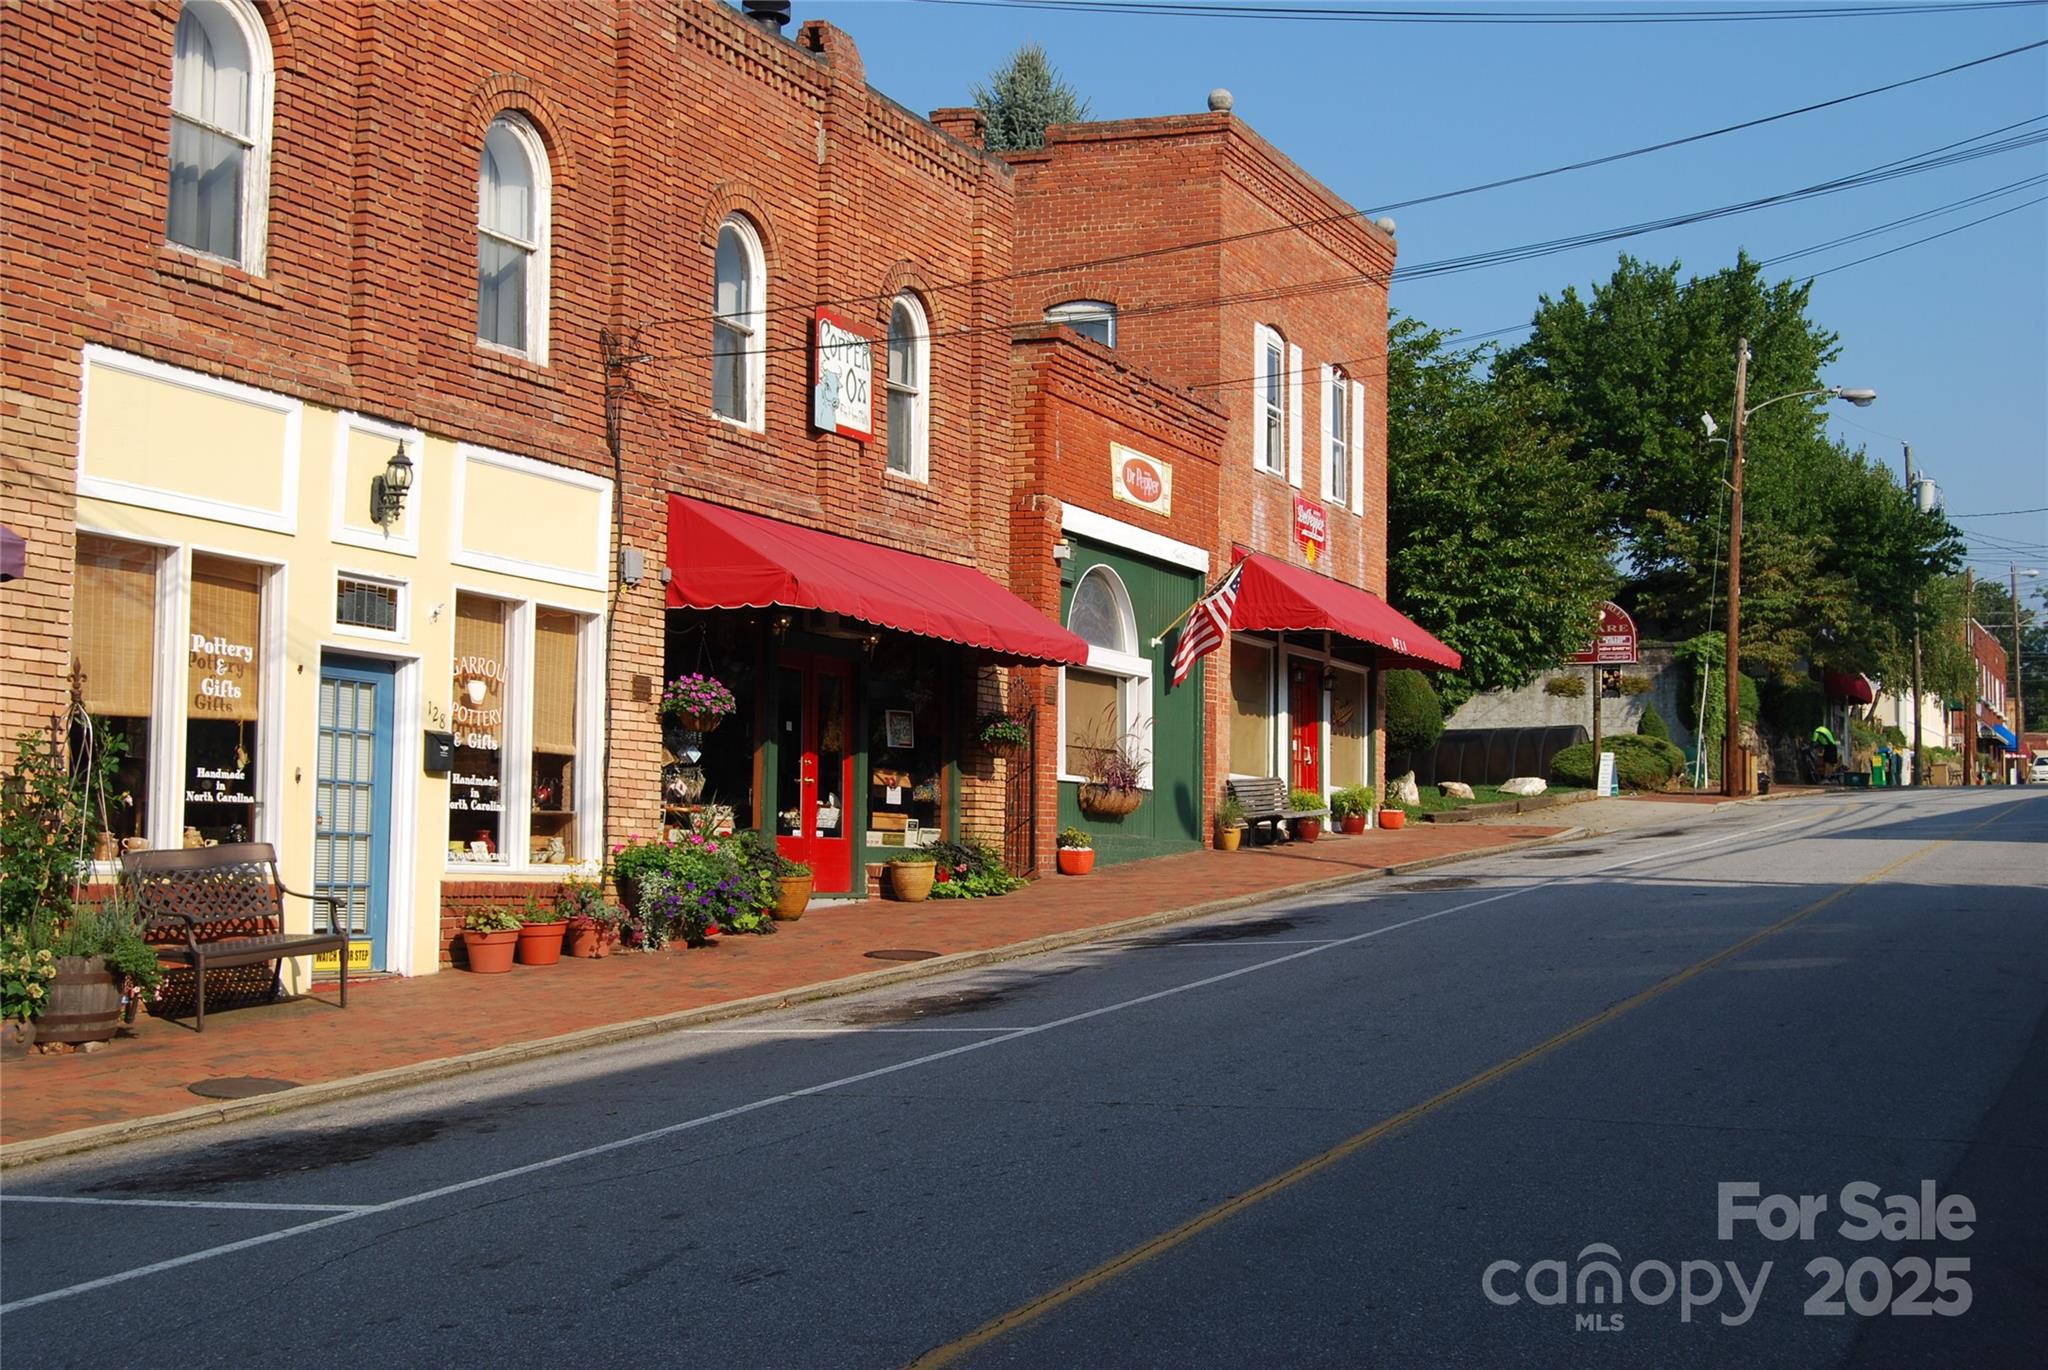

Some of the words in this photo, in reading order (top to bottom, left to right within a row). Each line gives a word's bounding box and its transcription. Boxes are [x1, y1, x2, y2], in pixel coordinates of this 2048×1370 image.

[190, 633, 254, 663] Pottery
[216, 658, 229, 676] &
[201, 678, 242, 699] Gifts
[428, 700, 446, 730] 128
[453, 701, 502, 726] POTTERY
[453, 731, 462, 747] &
[468, 732, 498, 750] Gifts
[196, 767, 246, 780] Handmade
[452, 773, 498, 786] Handmade
[215, 780, 226, 791] in
[185, 790, 214, 802] North
[216, 791, 255, 803] Carolina
[470, 787, 480, 798] in
[450, 799, 469, 810] orth
[470, 799, 506, 812] Carolina
[354, 949, 369, 961] STEP
